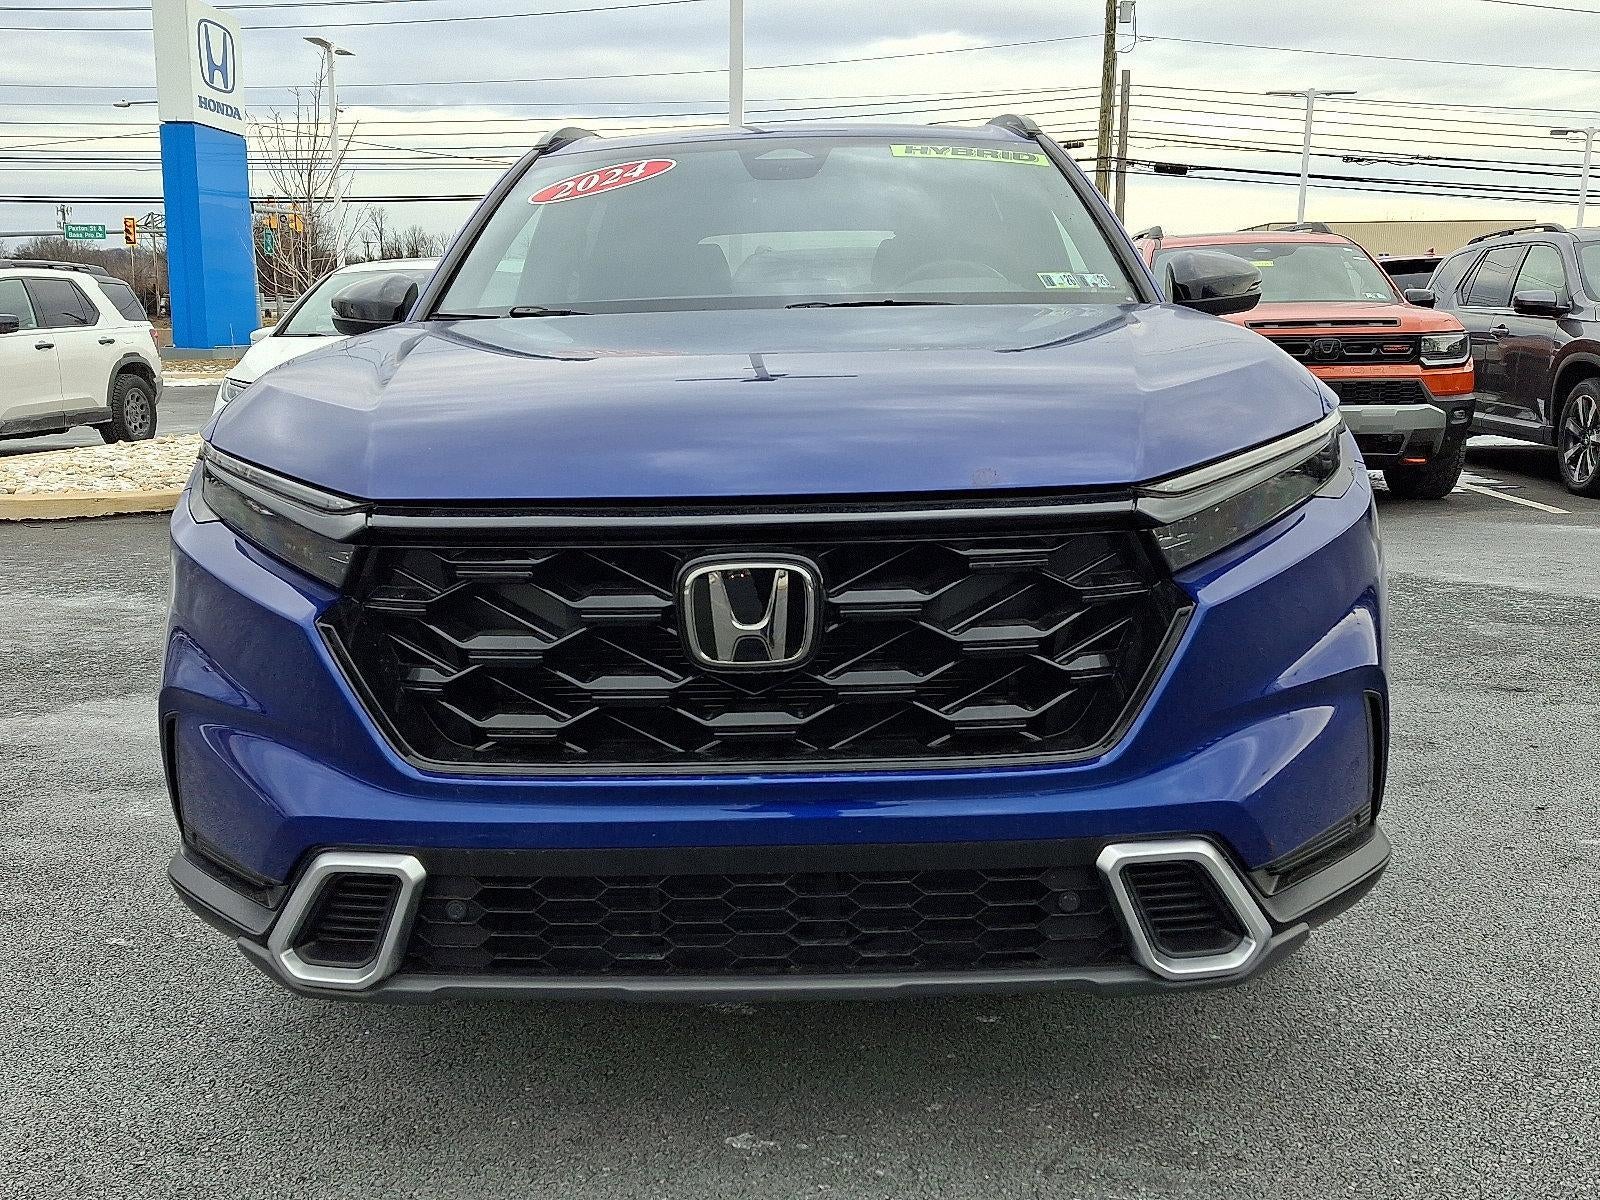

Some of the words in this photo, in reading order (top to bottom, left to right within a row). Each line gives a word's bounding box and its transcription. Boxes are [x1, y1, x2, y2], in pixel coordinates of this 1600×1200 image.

[197, 94, 242, 121] HONDA
[904, 145, 1038, 162] HYBRID
[550, 160, 648, 201] 2024
